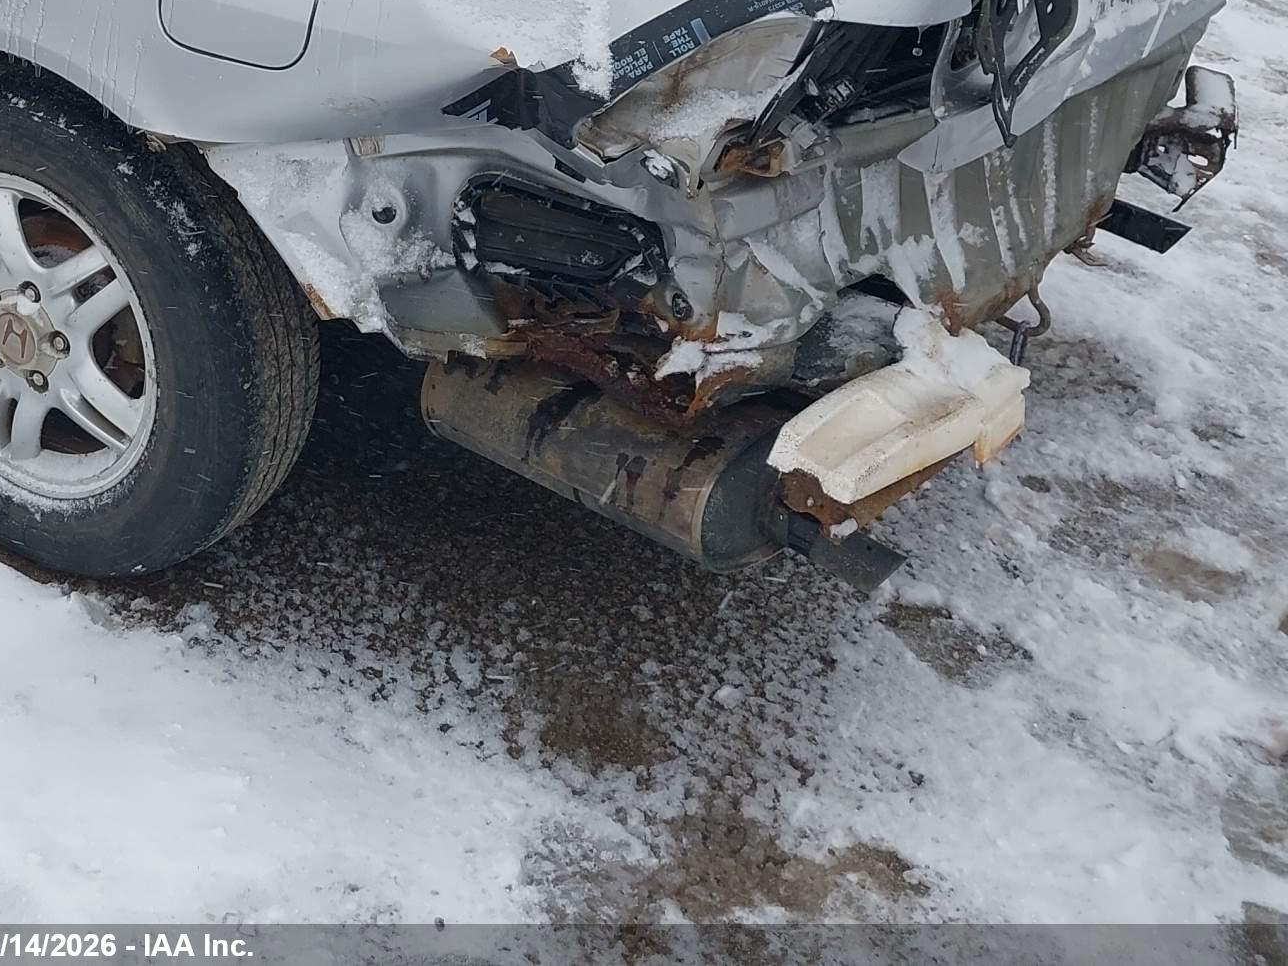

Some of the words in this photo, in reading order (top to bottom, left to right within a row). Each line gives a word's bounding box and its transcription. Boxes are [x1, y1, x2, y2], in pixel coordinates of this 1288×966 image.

[662, 26, 688, 44] TAPE
[671, 34, 692, 48] THE
[634, 47, 647, 58] EL
[669, 40, 695, 57] ROLL
[628, 61, 654, 79] PARA
